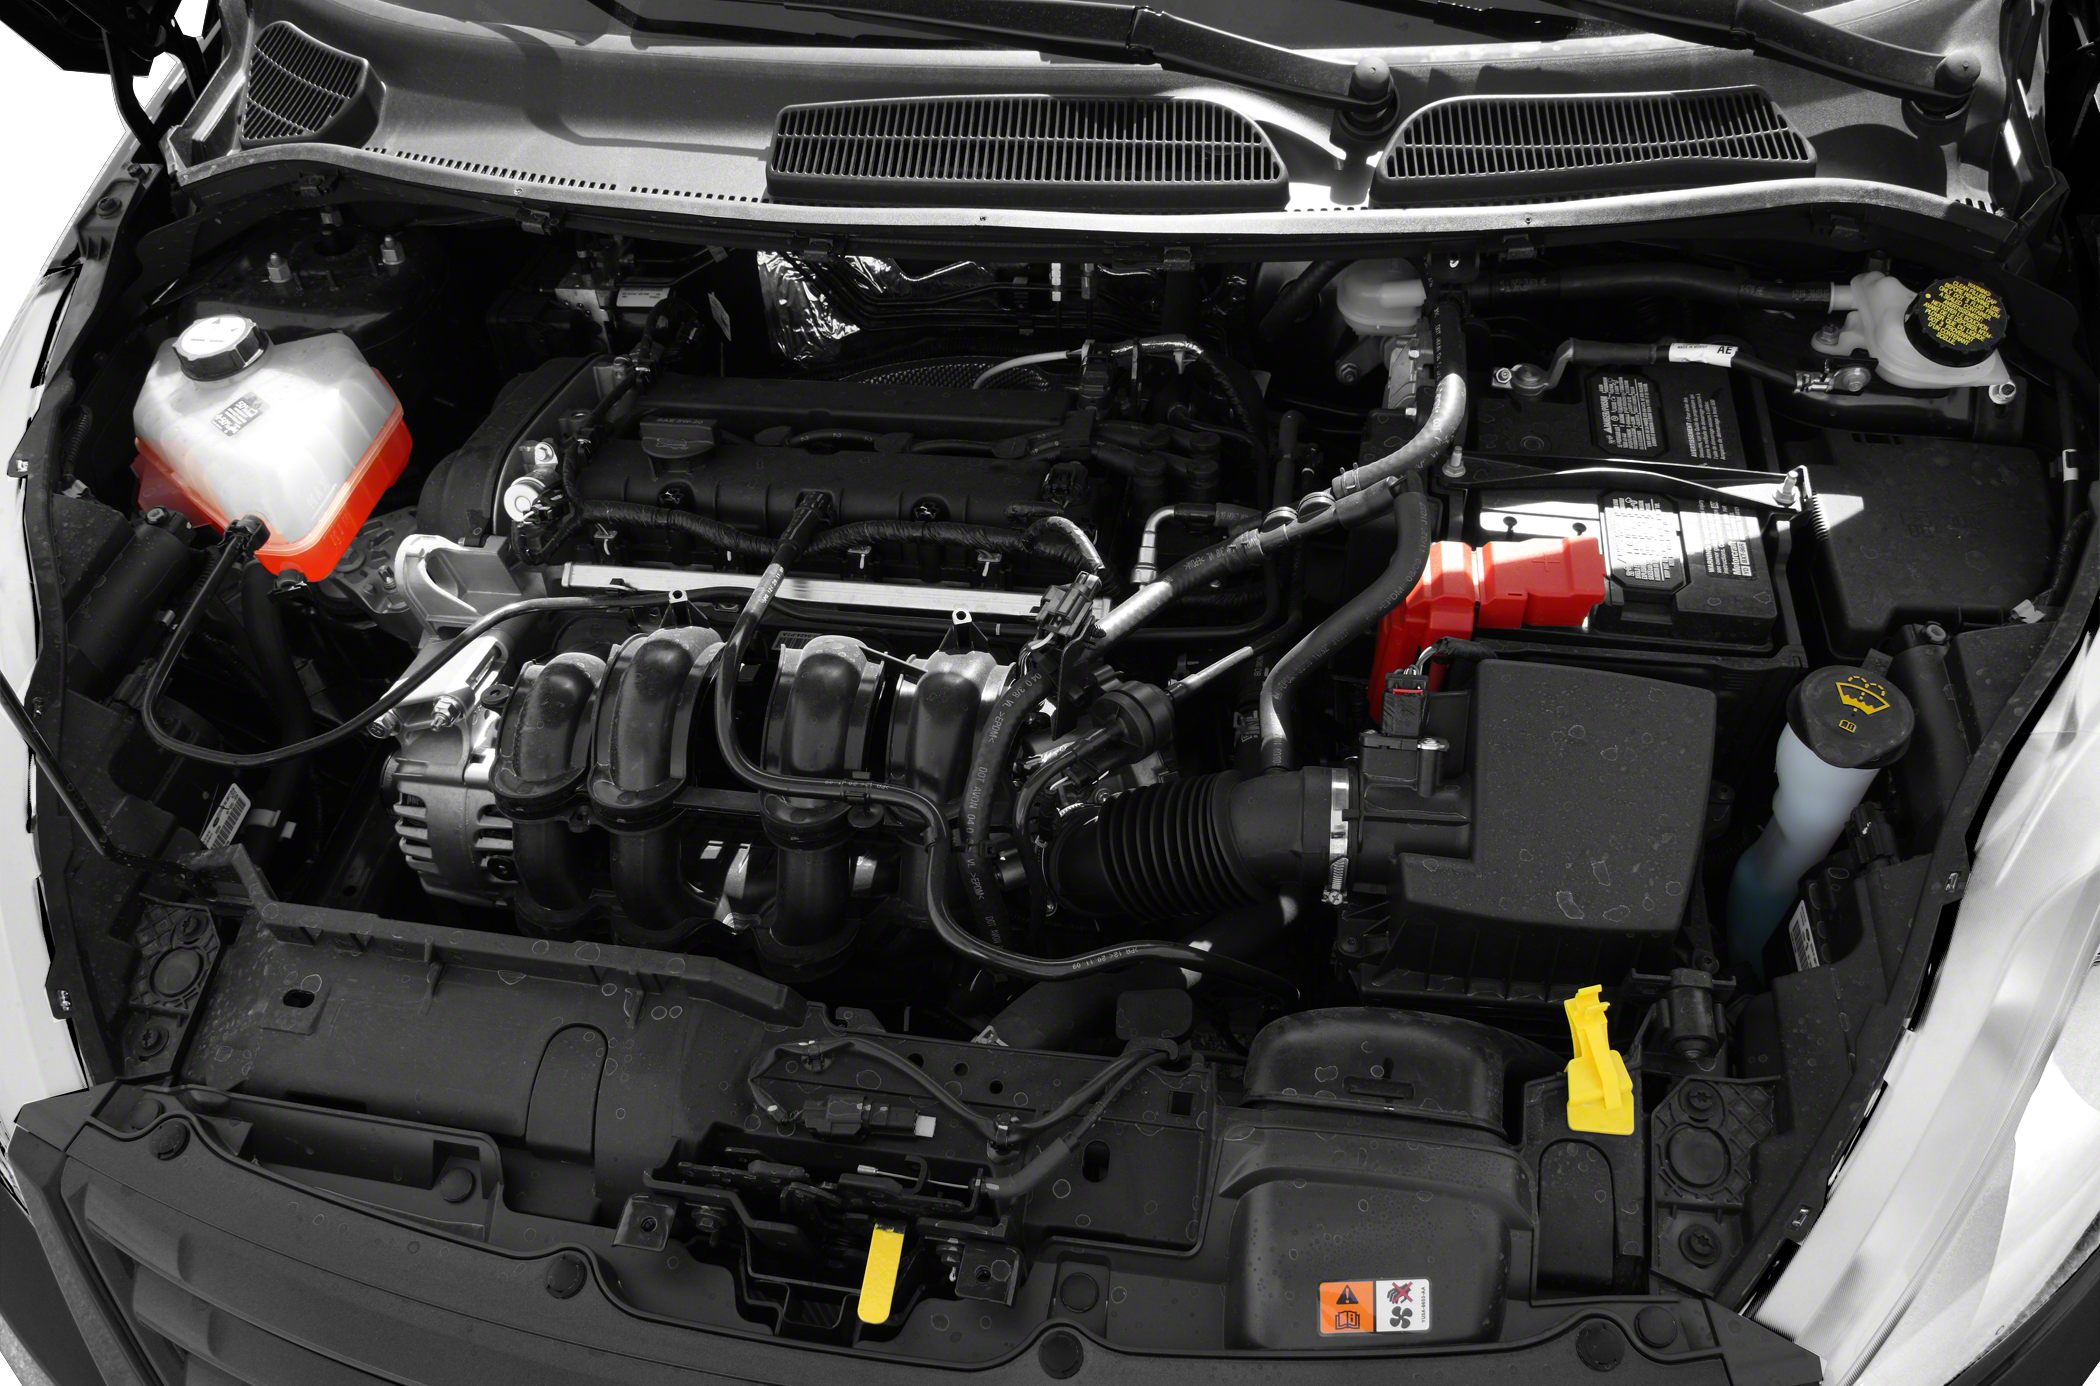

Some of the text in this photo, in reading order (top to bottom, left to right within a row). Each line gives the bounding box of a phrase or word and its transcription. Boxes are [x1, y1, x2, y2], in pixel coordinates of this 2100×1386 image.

[1717, 345, 1732, 355] AE
[1728, 541, 1741, 574] Motorcraft
[976, 767, 988, 783] DOT
[970, 786, 982, 809] AVON
